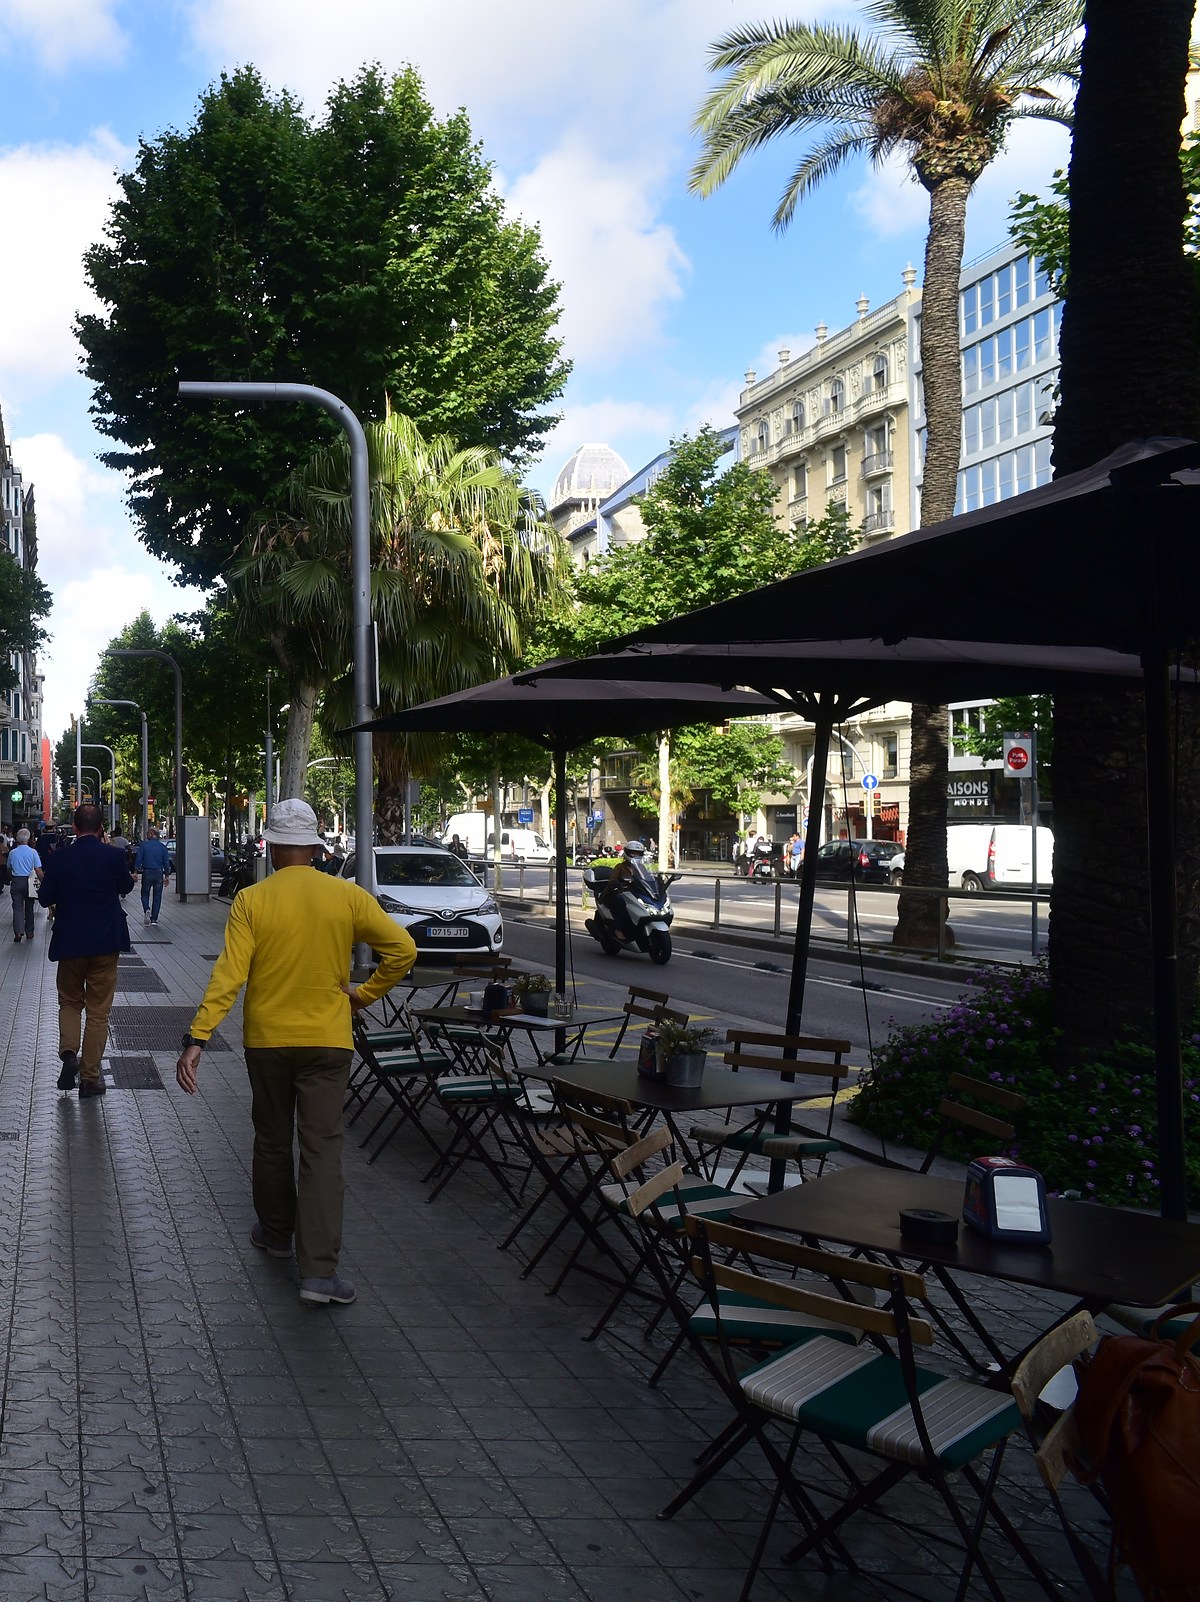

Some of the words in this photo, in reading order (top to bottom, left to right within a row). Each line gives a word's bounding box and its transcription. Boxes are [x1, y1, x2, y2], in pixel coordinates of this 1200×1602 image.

[953, 798, 989, 807] MONDE
[587, 816, 593, 824] P
[432, 928, 452, 936] 0715
